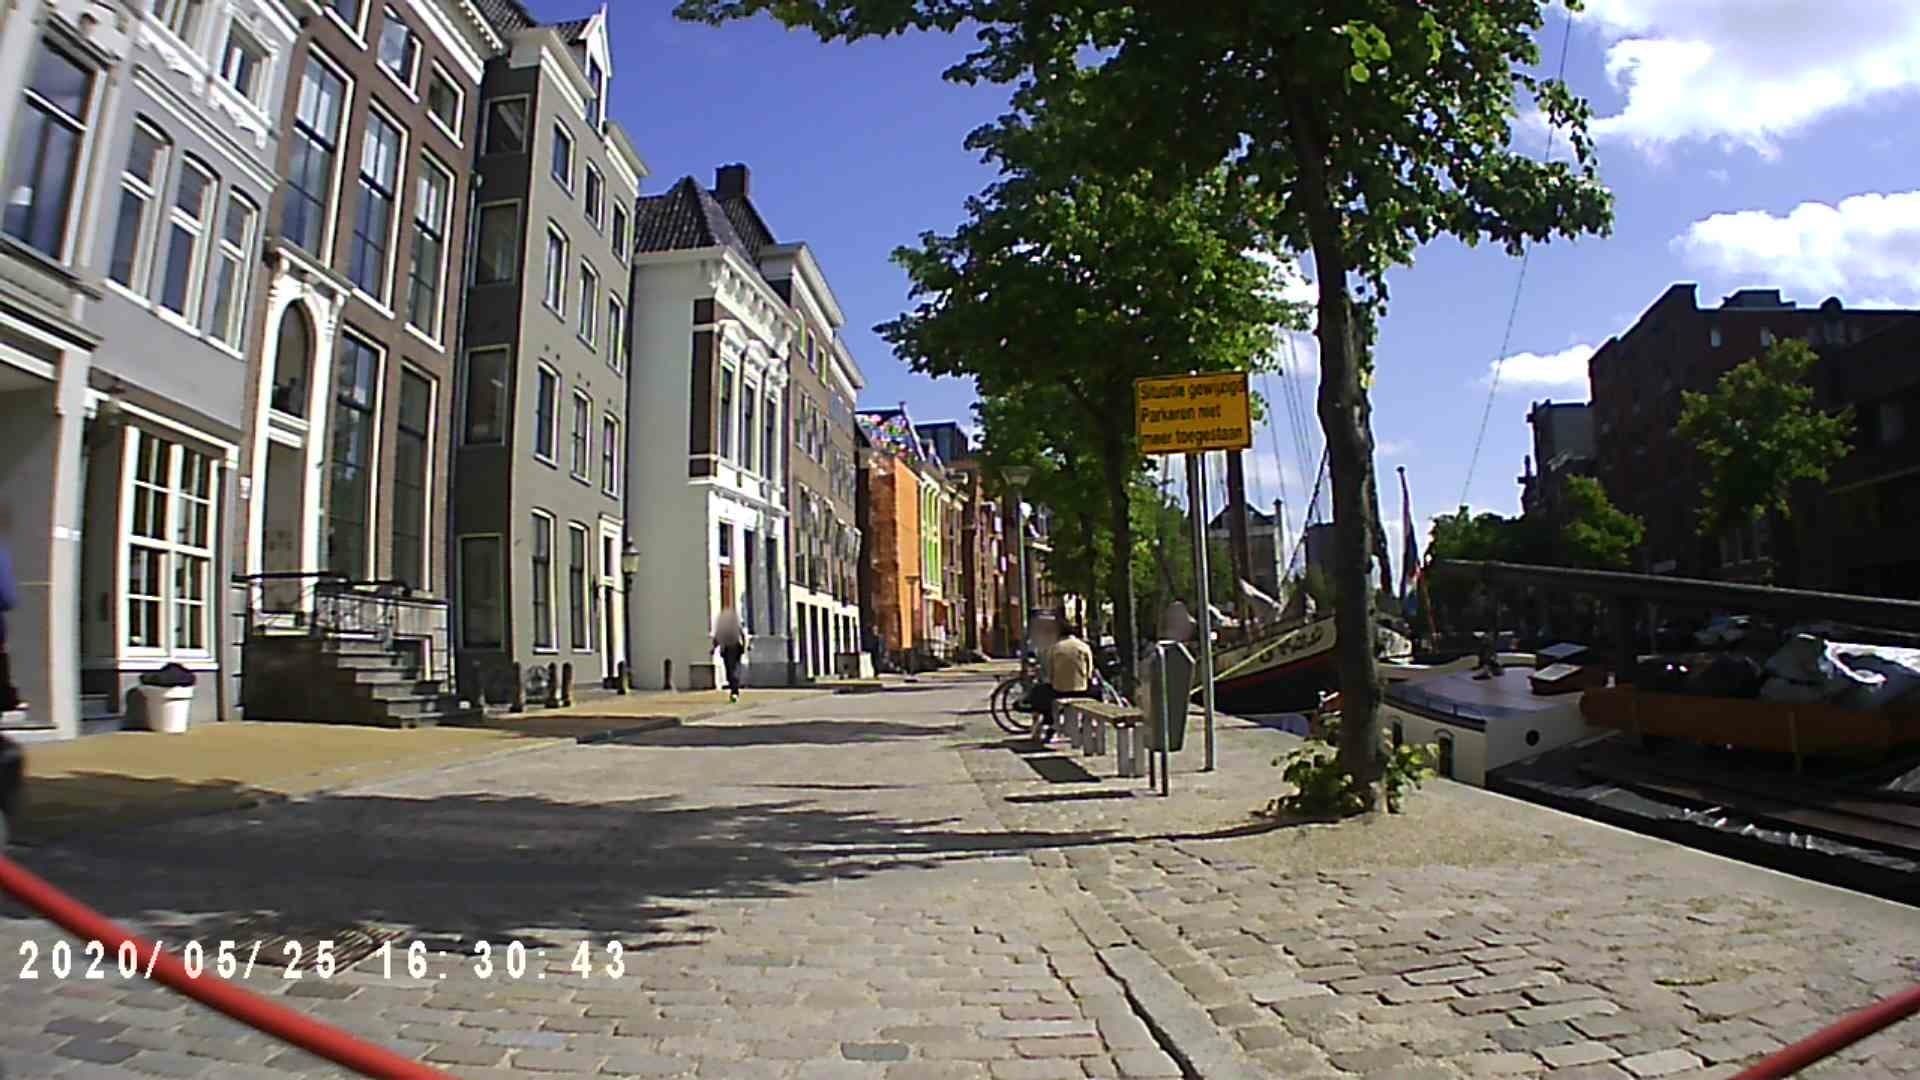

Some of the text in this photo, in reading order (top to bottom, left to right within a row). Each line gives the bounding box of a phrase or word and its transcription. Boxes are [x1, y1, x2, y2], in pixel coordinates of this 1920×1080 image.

[1140, 384, 1185, 400] Situatie
[1140, 403, 1222, 422] Parkeren niet
[1142, 427, 1242, 447] meer toegestaan
